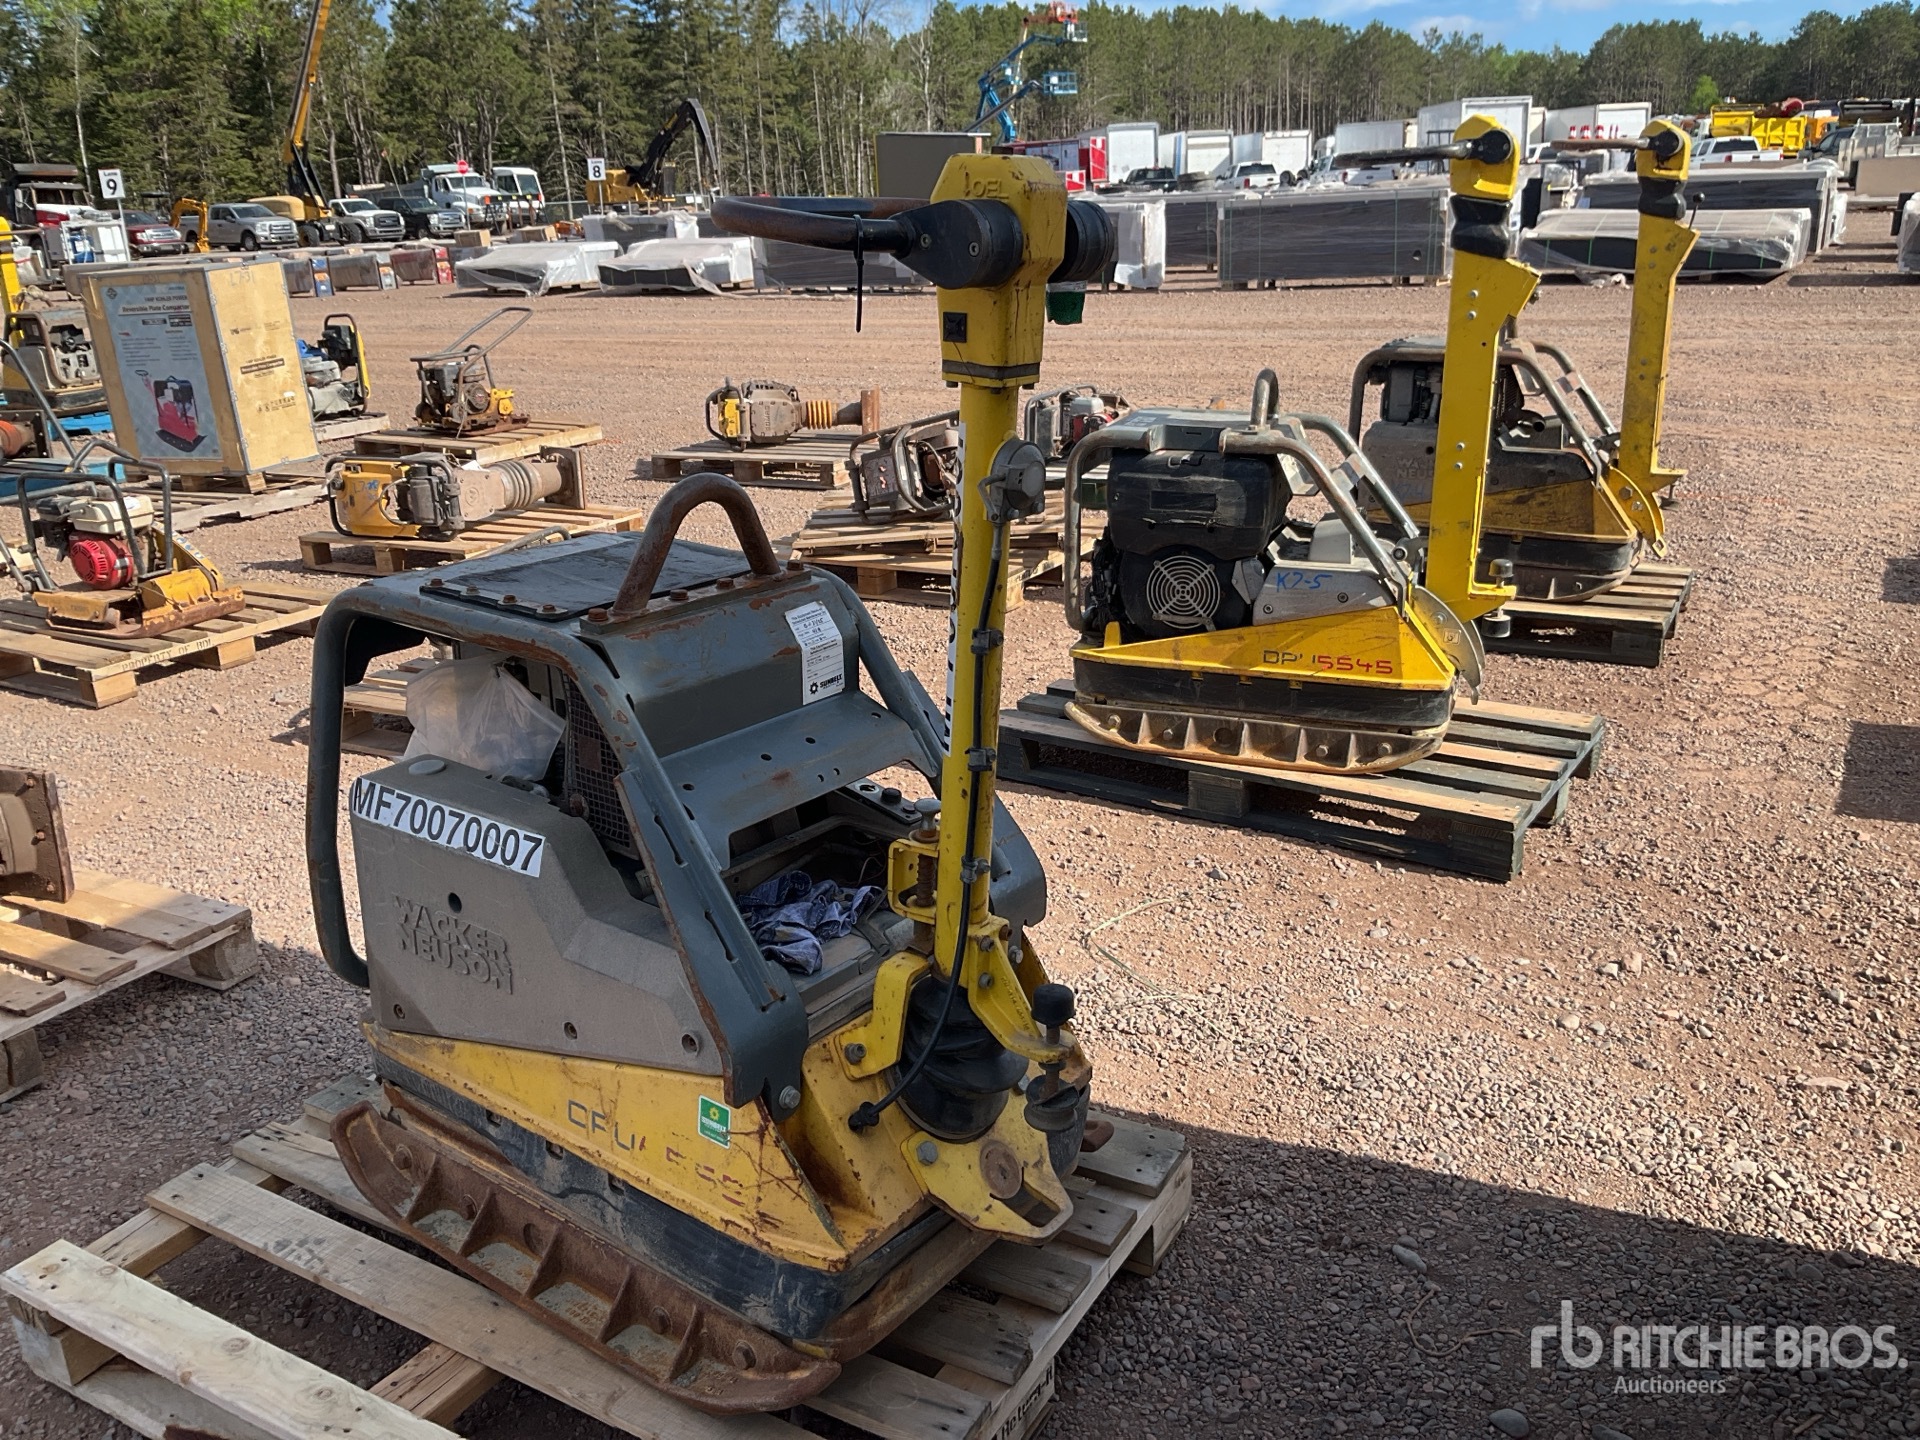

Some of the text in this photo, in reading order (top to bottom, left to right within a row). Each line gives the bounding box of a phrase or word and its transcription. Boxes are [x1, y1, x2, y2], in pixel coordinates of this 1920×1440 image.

[107, 179, 117, 195] 9
[593, 165, 601, 178] 8
[1276, 572, 1332, 592] K7-5
[353, 777, 543, 871] MF70070007
[392, 892, 511, 967] WACKER
[400, 924, 513, 995] NEUSON
